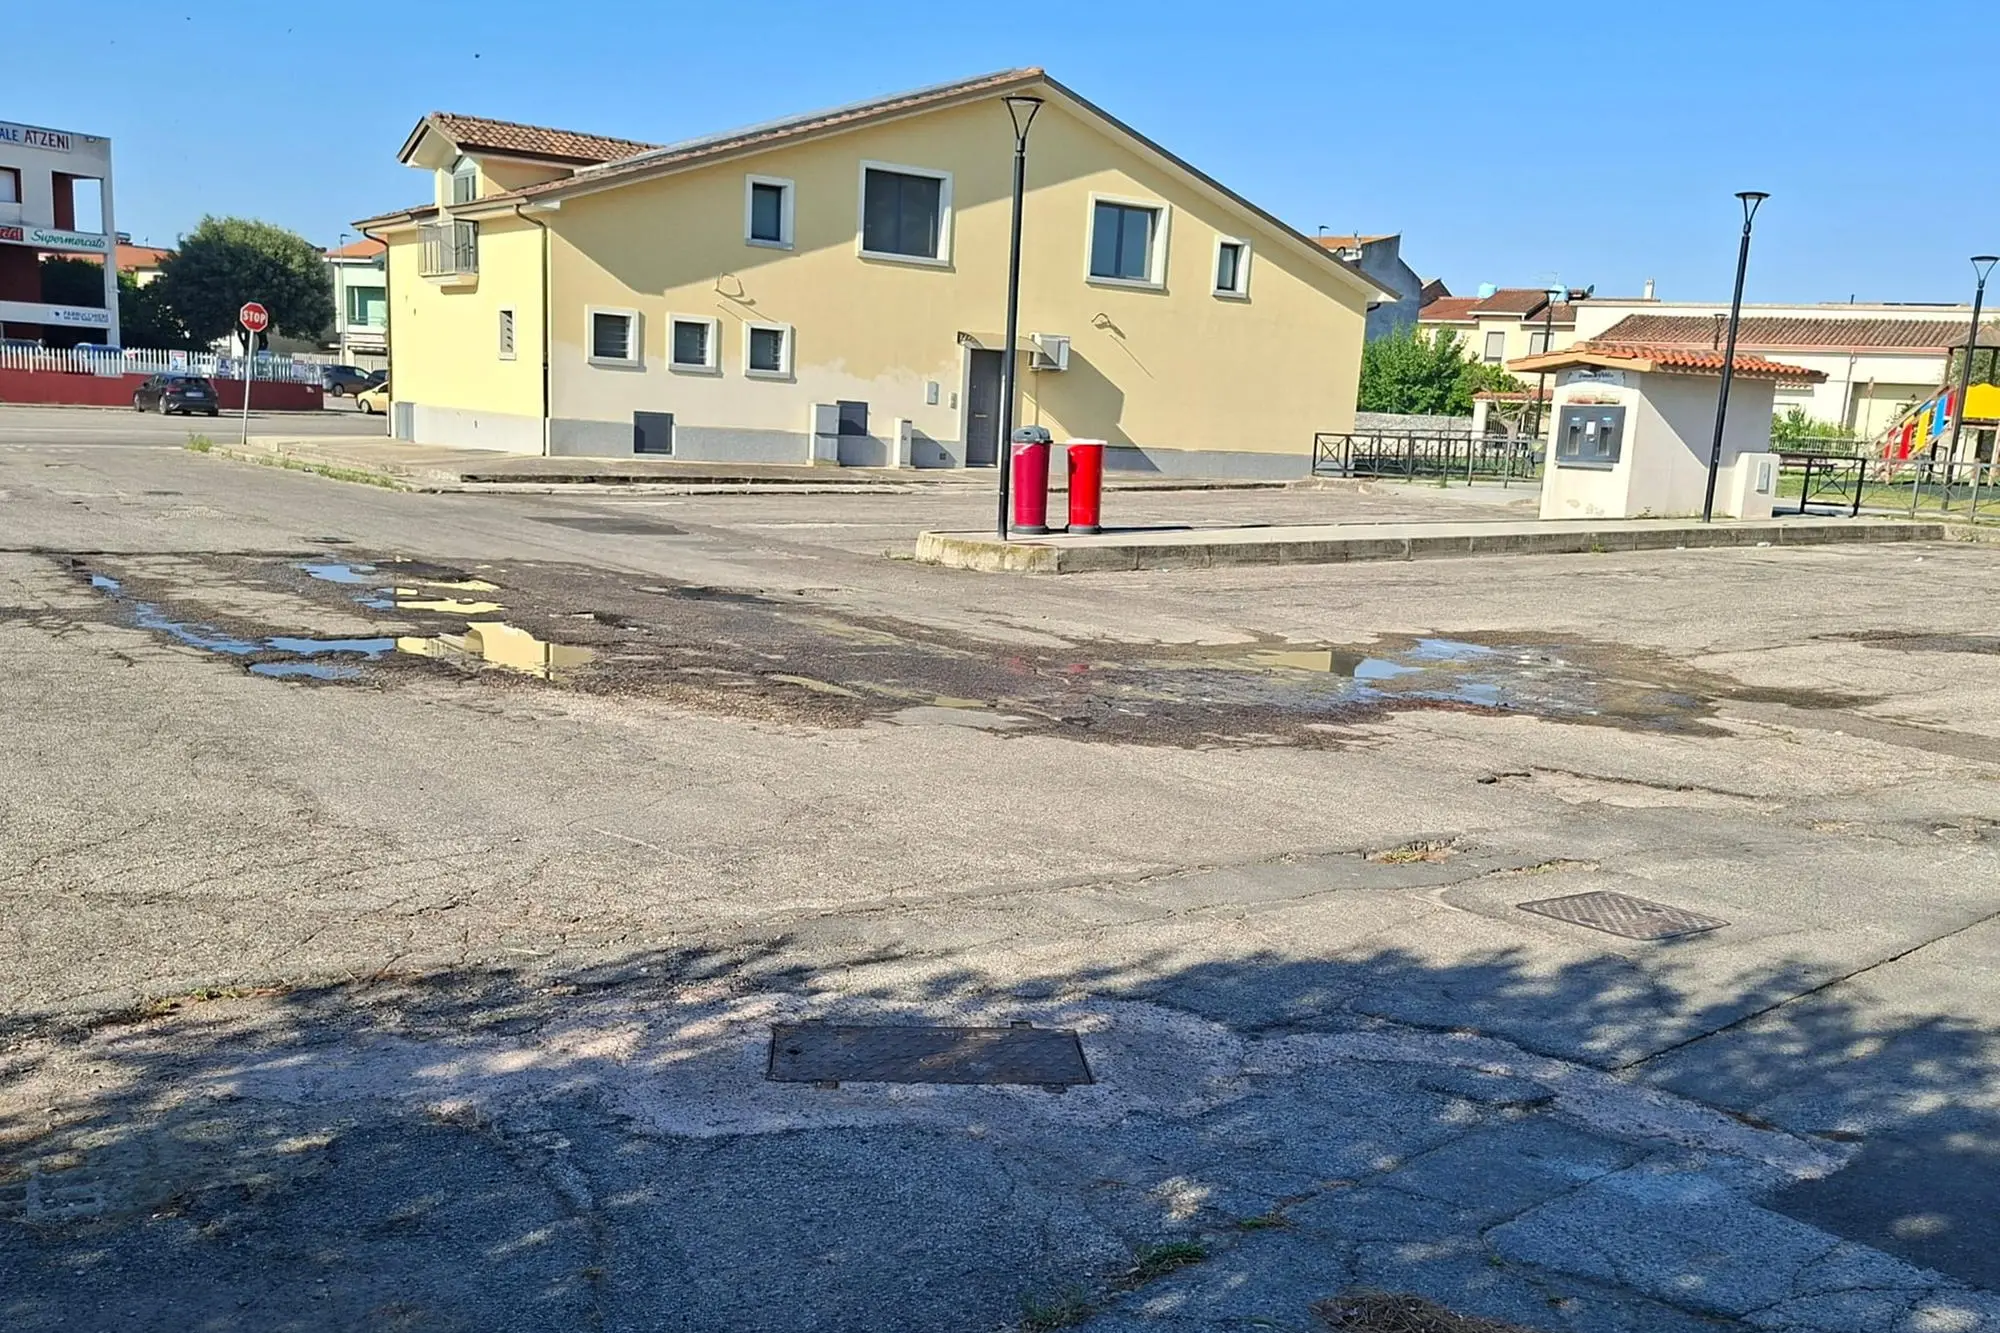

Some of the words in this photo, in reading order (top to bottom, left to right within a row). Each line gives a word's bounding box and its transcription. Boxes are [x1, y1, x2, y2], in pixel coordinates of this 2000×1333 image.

[24, 129, 70, 150] ATZENI
[31, 229, 105, 249] Supermercato
[243, 310, 266, 325] STOP
